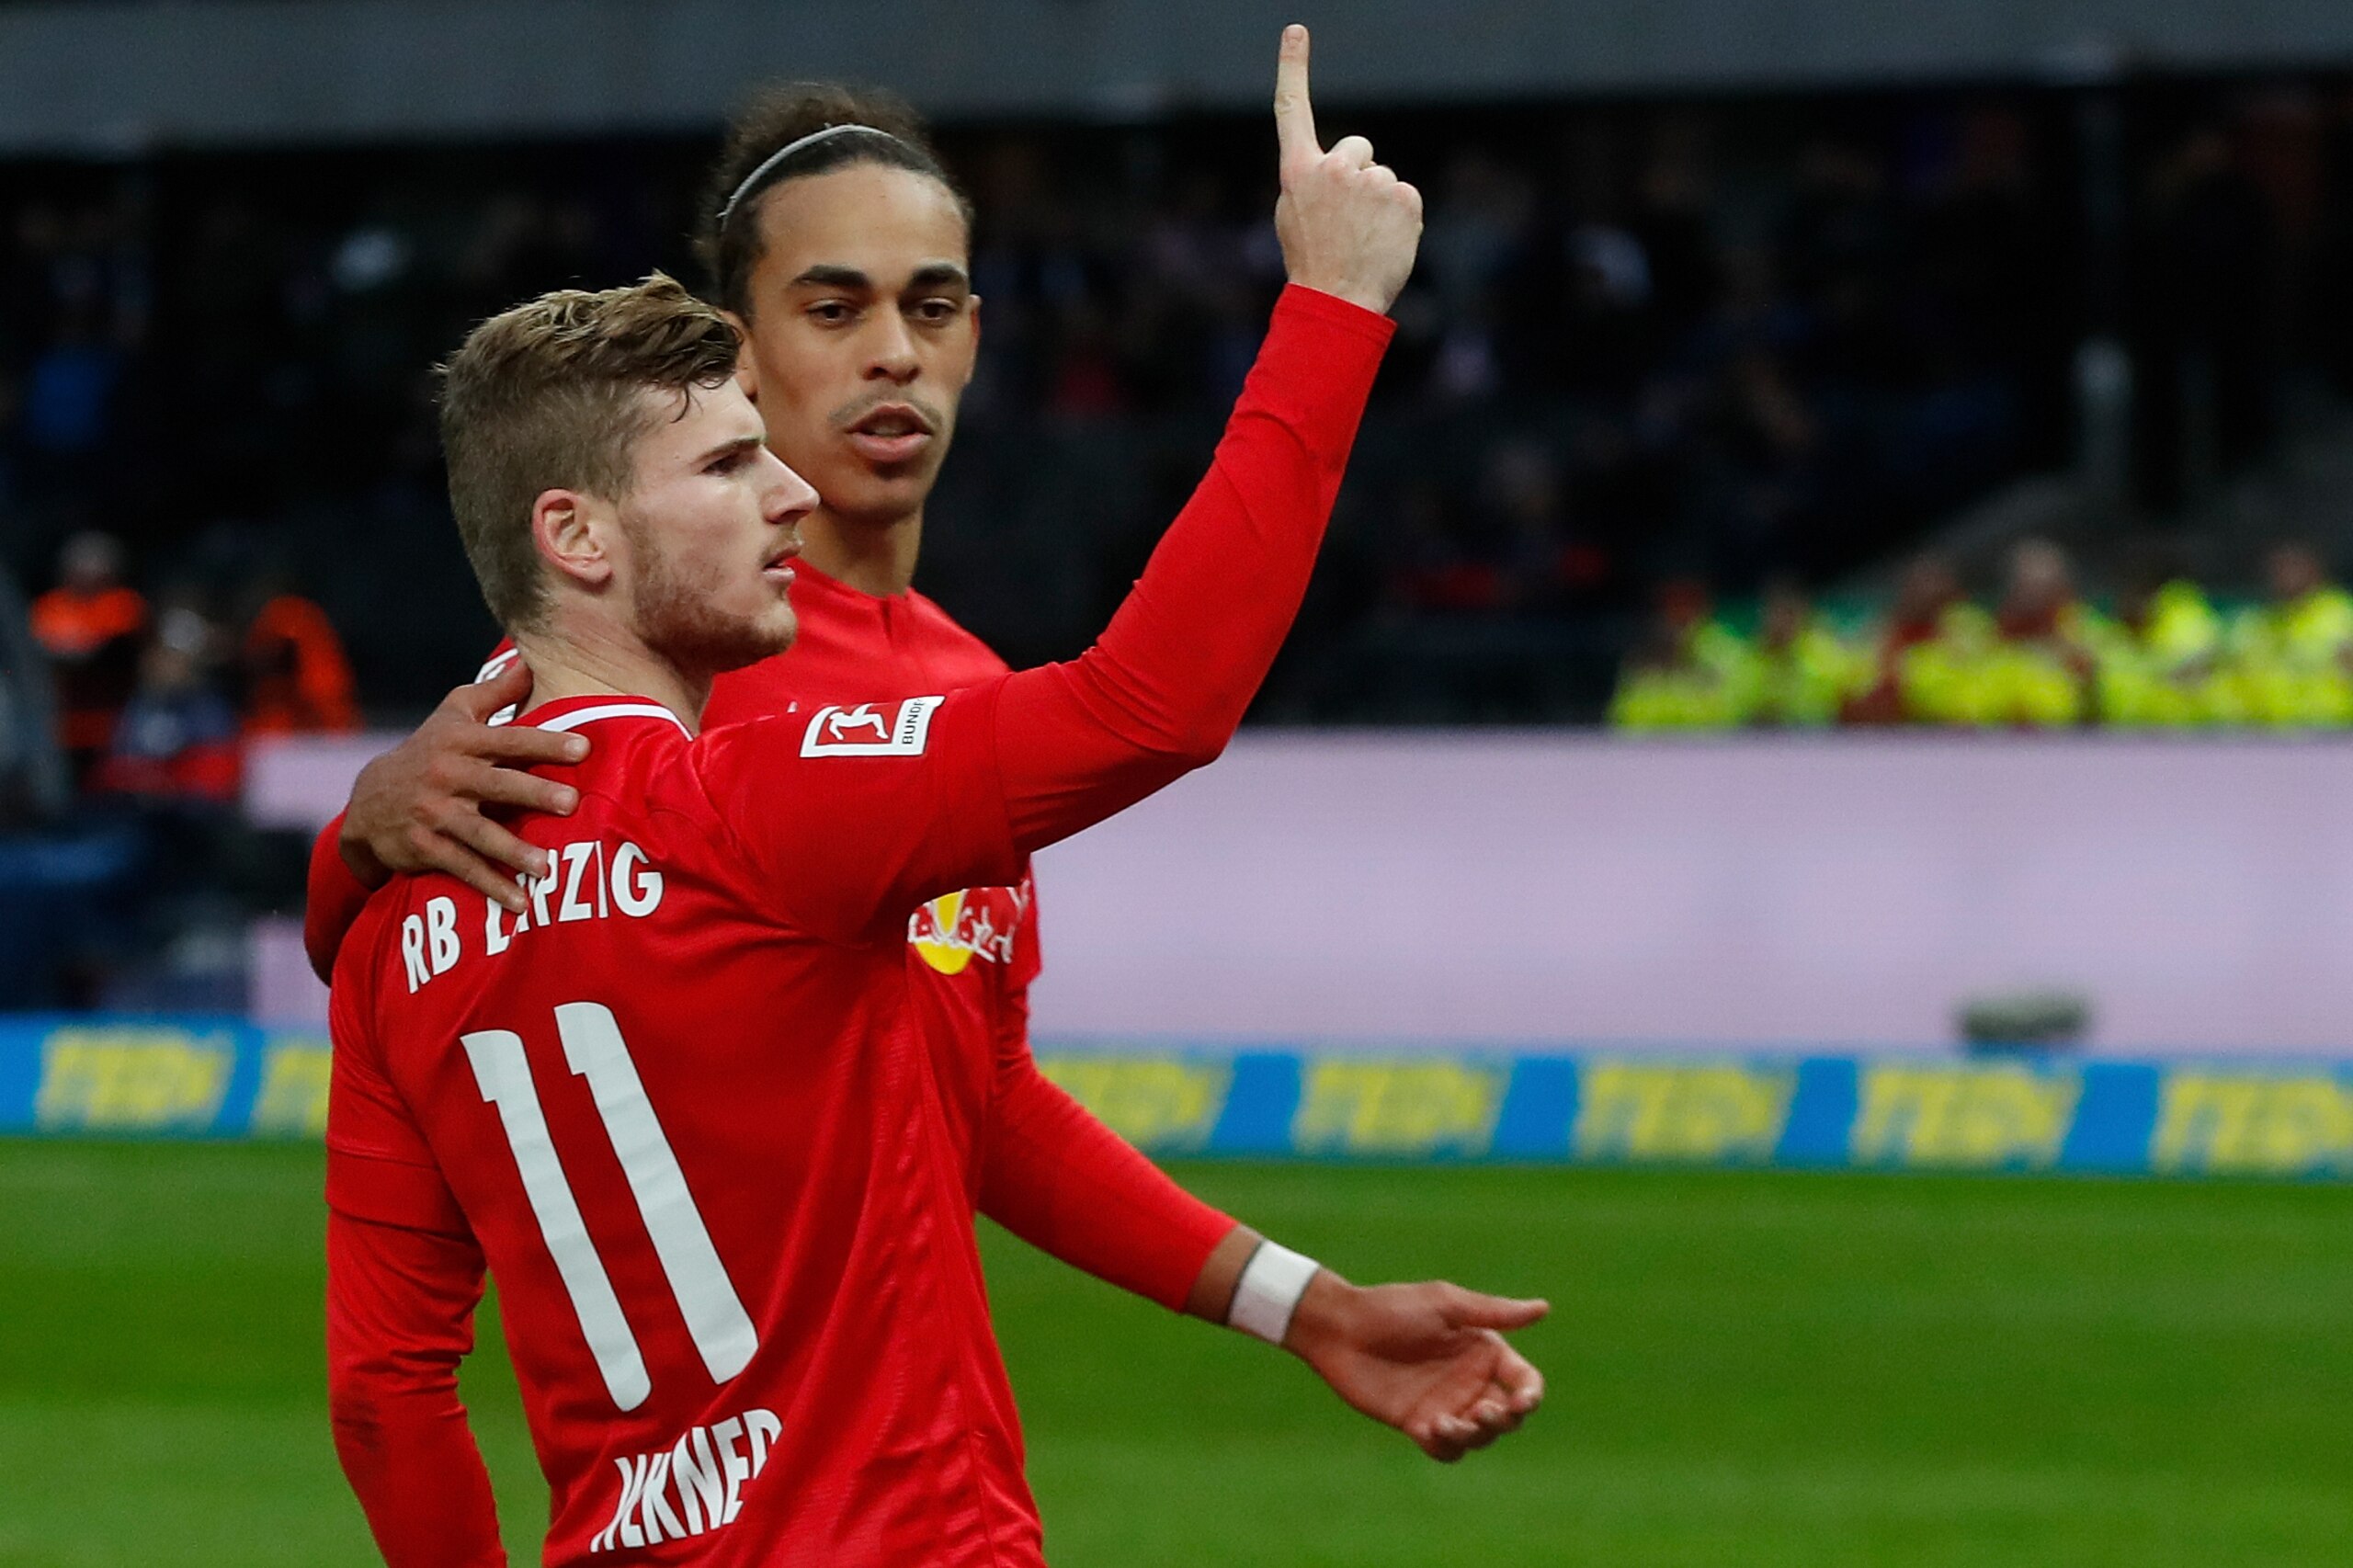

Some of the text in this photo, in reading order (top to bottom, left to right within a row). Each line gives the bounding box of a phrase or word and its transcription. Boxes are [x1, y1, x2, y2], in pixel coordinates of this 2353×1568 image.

[402, 840, 665, 994] RB LPZIG
[459, 1000, 761, 1413] 11
